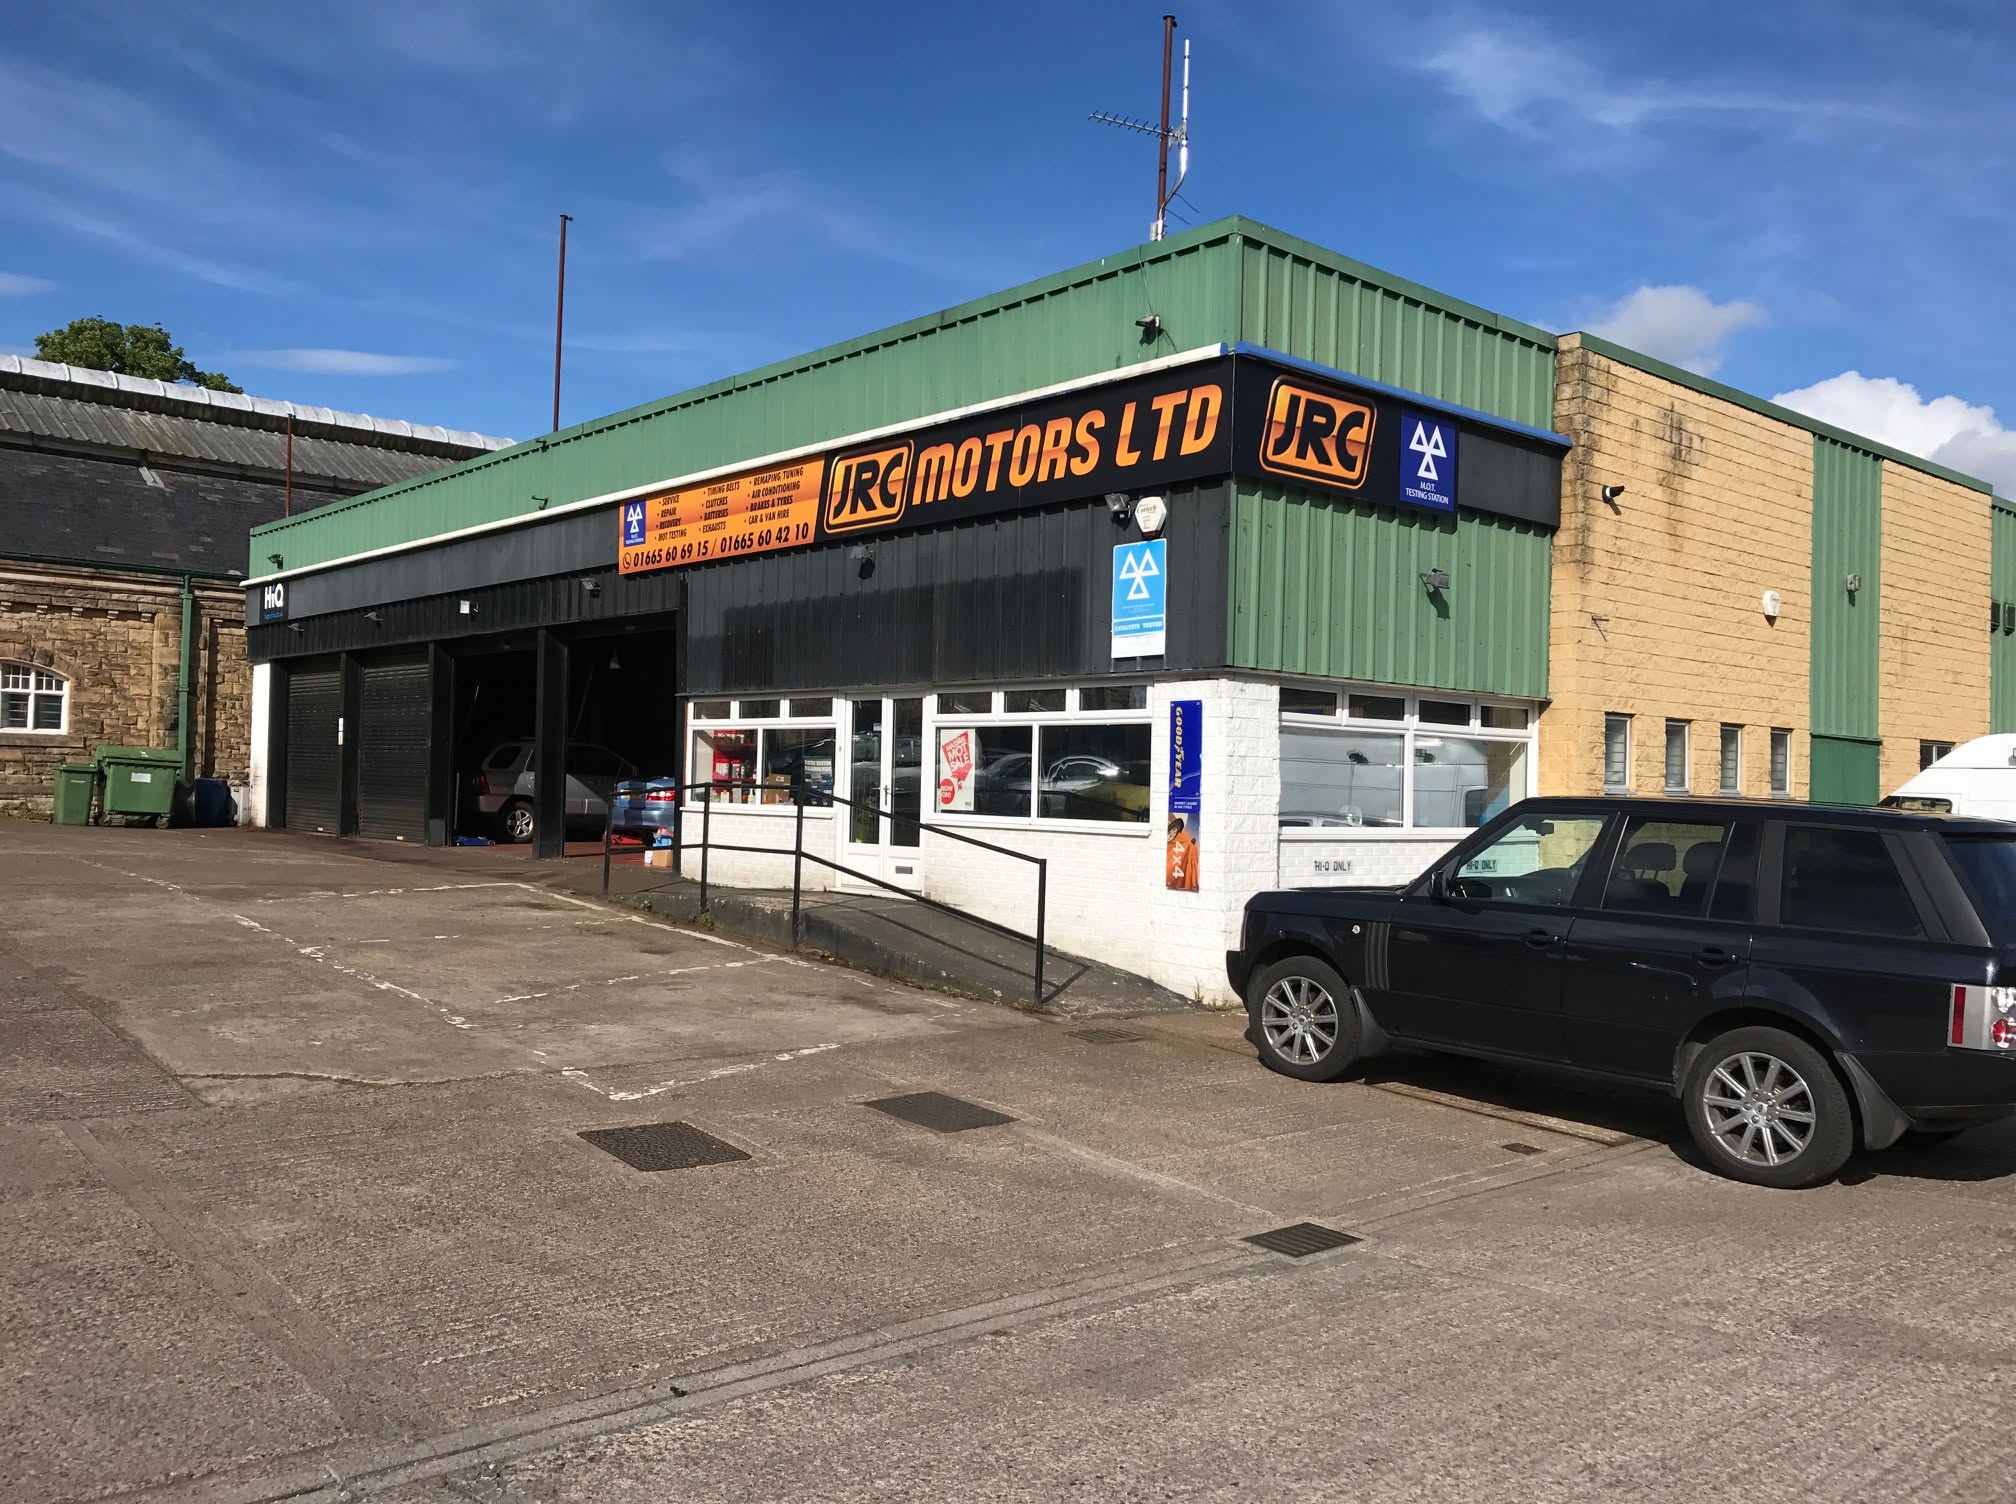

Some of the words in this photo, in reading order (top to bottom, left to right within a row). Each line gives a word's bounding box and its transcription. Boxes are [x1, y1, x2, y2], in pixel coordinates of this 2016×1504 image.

[1271, 393, 1367, 473] JRC
[832, 452, 903, 520] JRC
[911, 408, 1105, 505] MOTORS
[1115, 384, 1223, 467] LTD
[783, 466, 804, 480] TUNING
[707, 484, 725, 496] TIMING
[726, 481, 740, 492] BELTS
[752, 489, 761, 499] AIR
[762, 480, 800, 497] CONDITIONING
[1405, 487, 1428, 500] TESTING
[1428, 492, 1449, 504] STATION
[662, 495, 680, 506] SERVICE
[705, 496, 728, 509] CLUTCHES
[750, 500, 770, 512] BRAKES
[771, 498, 775, 507] &
[777, 495, 793, 506] TYRES
[661, 507, 677, 518] REPAIR
[703, 508, 728, 521] BATTERIES
[748, 514, 758, 525] CAR
[759, 514, 763, 523] &
[765, 512, 776, 521] VAN
[777, 509, 790, 519] HIRE
[659, 518, 681, 529] RECOVERY
[702, 521, 726, 533] EXHAUSTS
[658, 532, 668, 542] MOT
[669, 529, 687, 540] TESTING
[633, 548, 663, 568] 01665
[665, 546, 678, 563] 60
[680, 543, 694, 560] 69
[697, 540, 709, 558] 15
[720, 532, 754, 553] 01665
[758, 529, 772, 547] 60
[776, 525, 790, 544] 42
[795, 522, 809, 540] 10
[264, 583, 284, 609] HiQ
[947, 742, 968, 762] MOT
[1174, 706, 1185, 789] GOODYEAR
[949, 754, 970, 772] SALE
[1333, 860, 1352, 872] ONLY
[1481, 859, 1497, 870] ONLY
